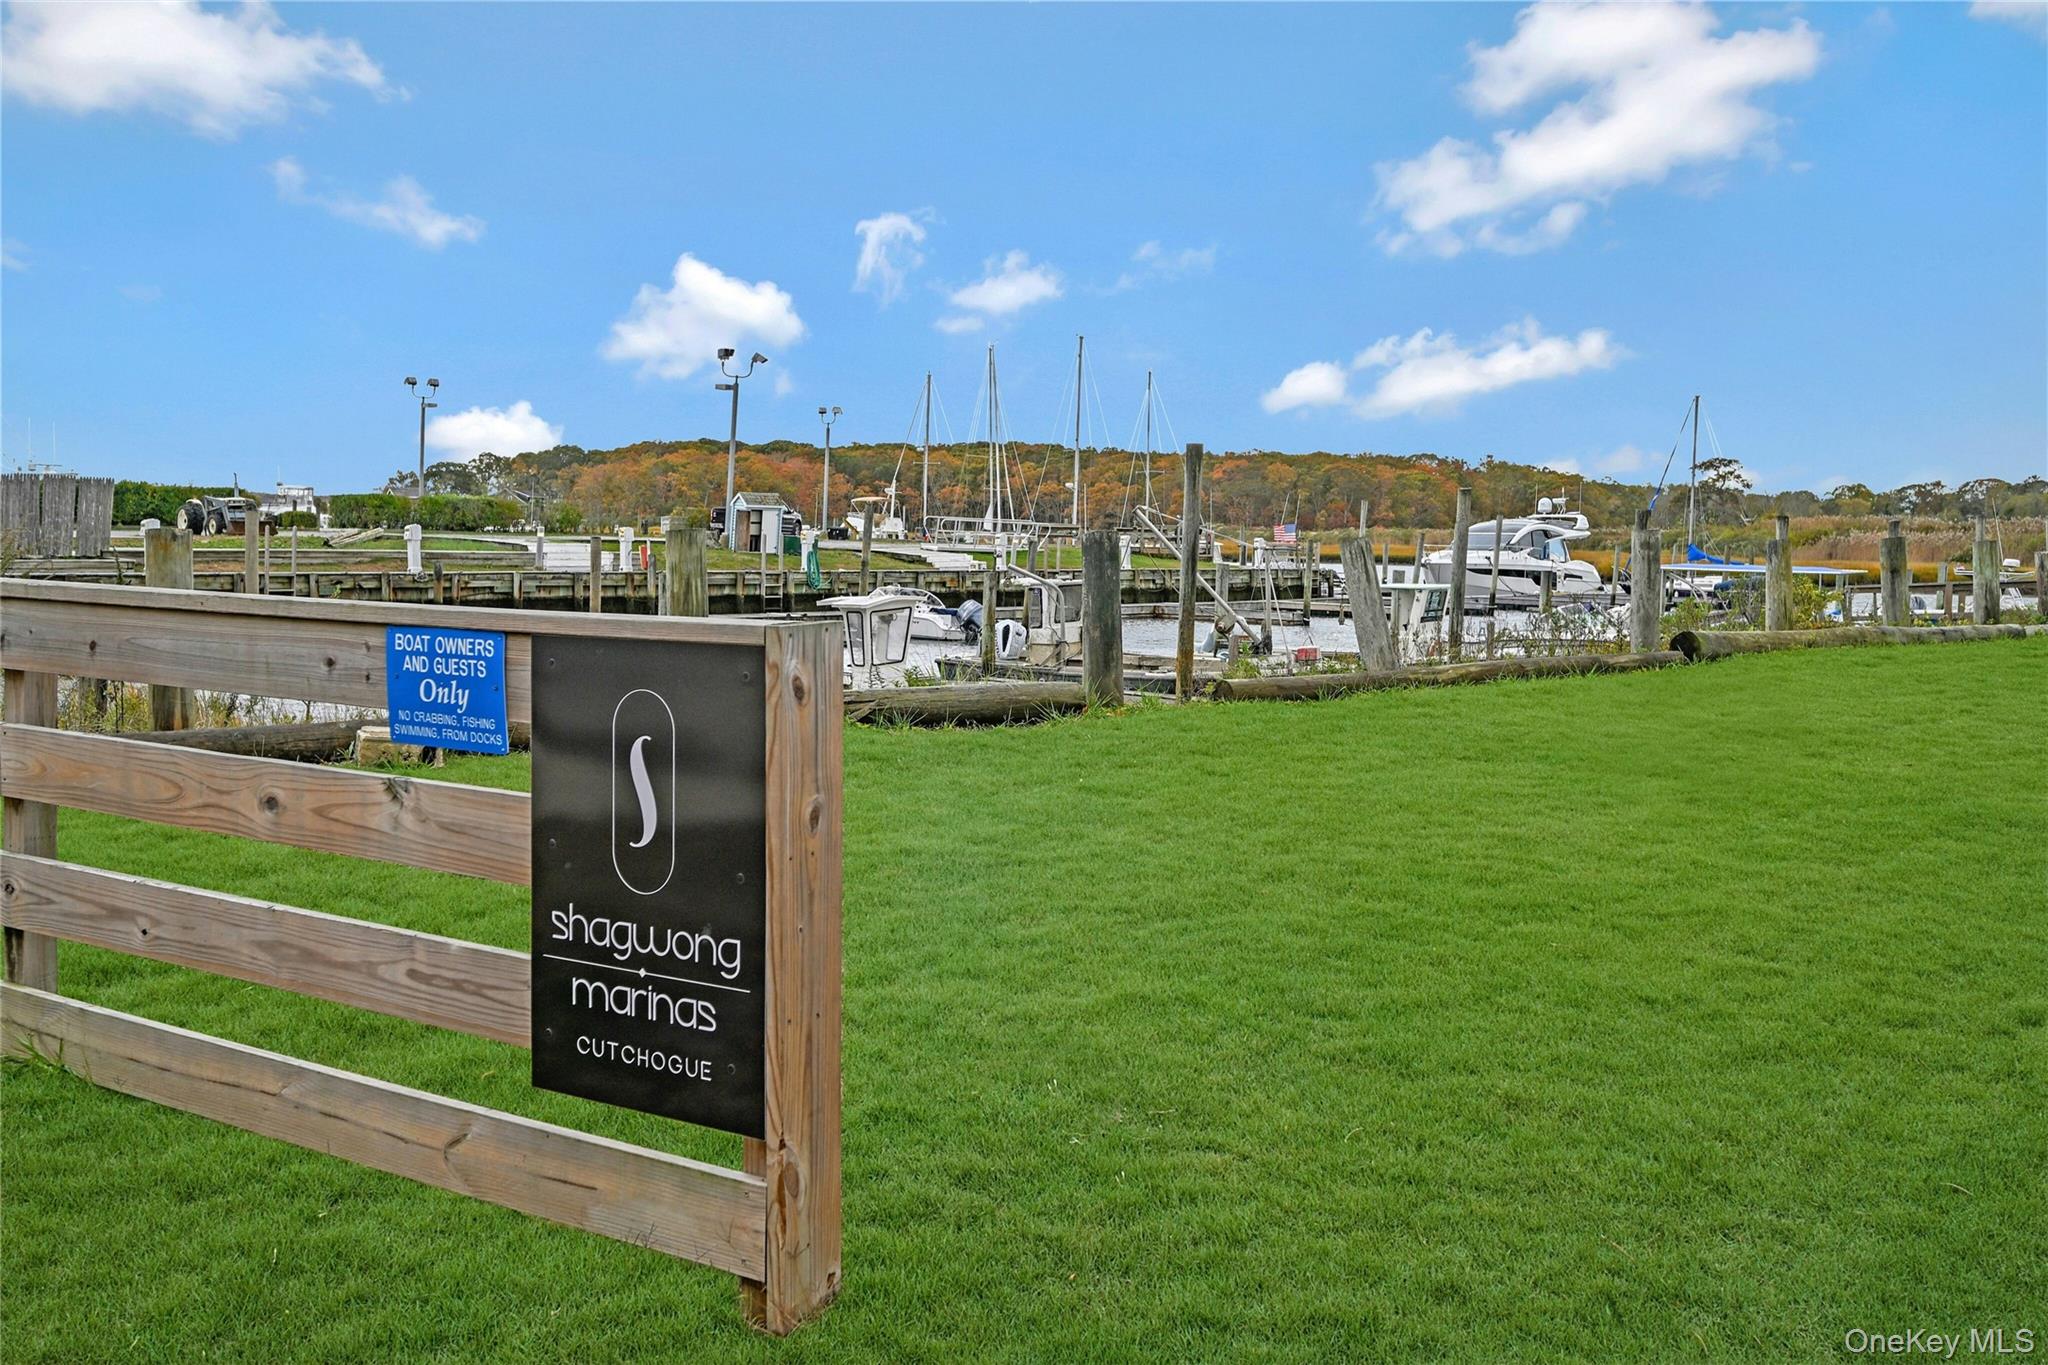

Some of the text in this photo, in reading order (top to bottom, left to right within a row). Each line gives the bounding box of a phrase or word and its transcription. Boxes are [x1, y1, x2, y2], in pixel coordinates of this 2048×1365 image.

[394, 633, 495, 657] BOAT OWNERS
[402, 655, 487, 678] AND GUESTS
[419, 678, 470, 714] Only
[398, 710, 411, 721] NO
[462, 716, 496, 730] FISHING
[442, 728, 468, 742] FROM
[470, 731, 503, 746] DOCKS
[551, 902, 742, 980] shagwong
[572, 976, 717, 1032] marinas
[576, 1035, 713, 1082] CUTCHOGUE
